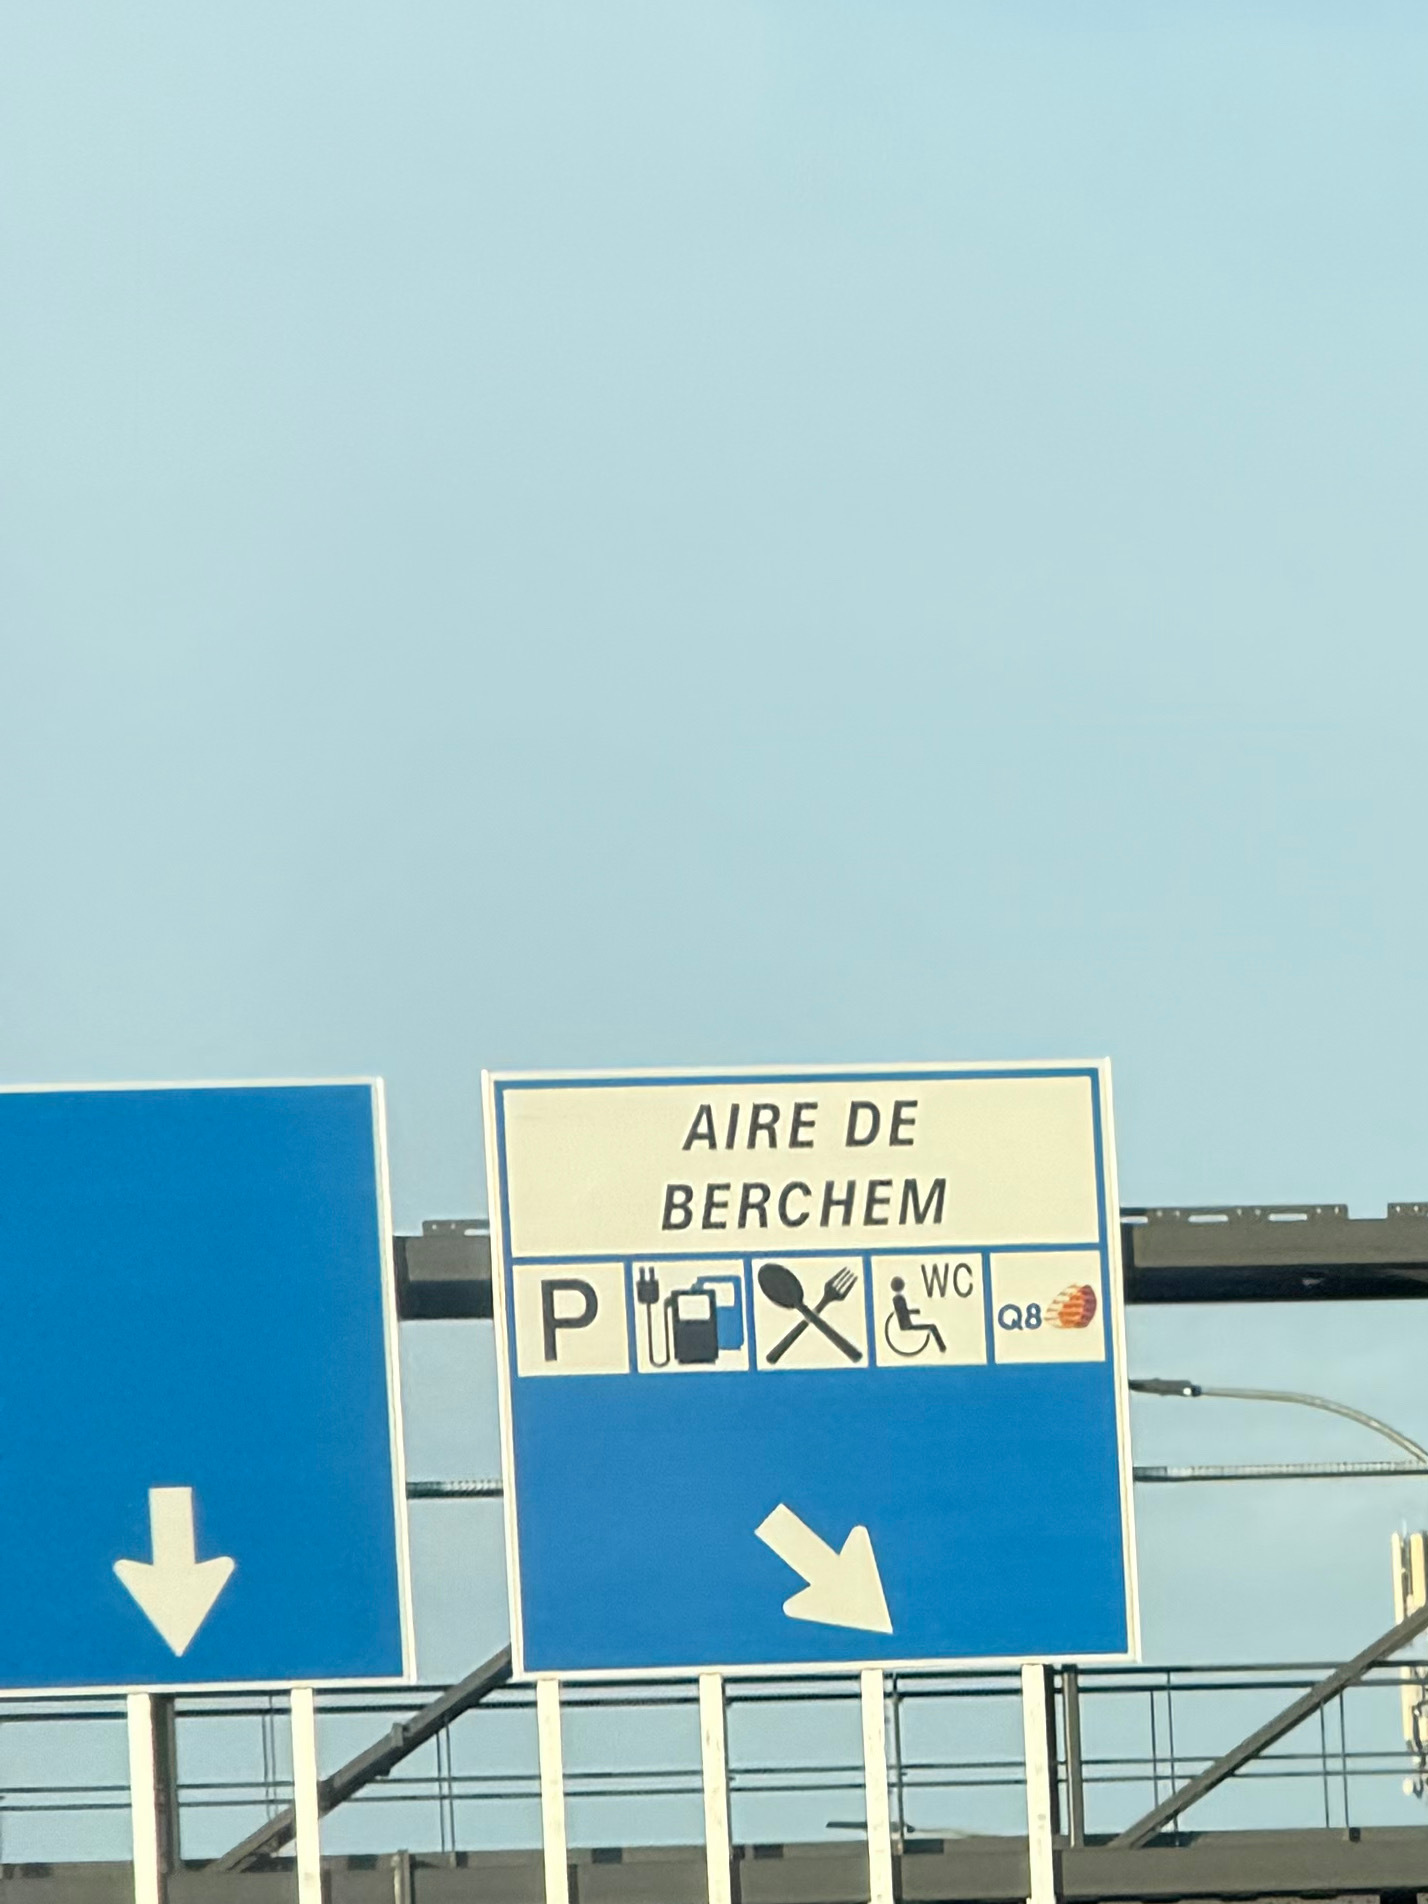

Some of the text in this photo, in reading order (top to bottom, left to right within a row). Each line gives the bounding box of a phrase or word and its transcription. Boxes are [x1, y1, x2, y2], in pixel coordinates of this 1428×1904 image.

[682, 1099, 919, 1151] AIRE DE
[660, 1177, 948, 1231] BERCHEM
[920, 1262, 975, 1299] WC
[540, 1278, 599, 1362] P
[997, 1302, 1043, 1332] Q8
